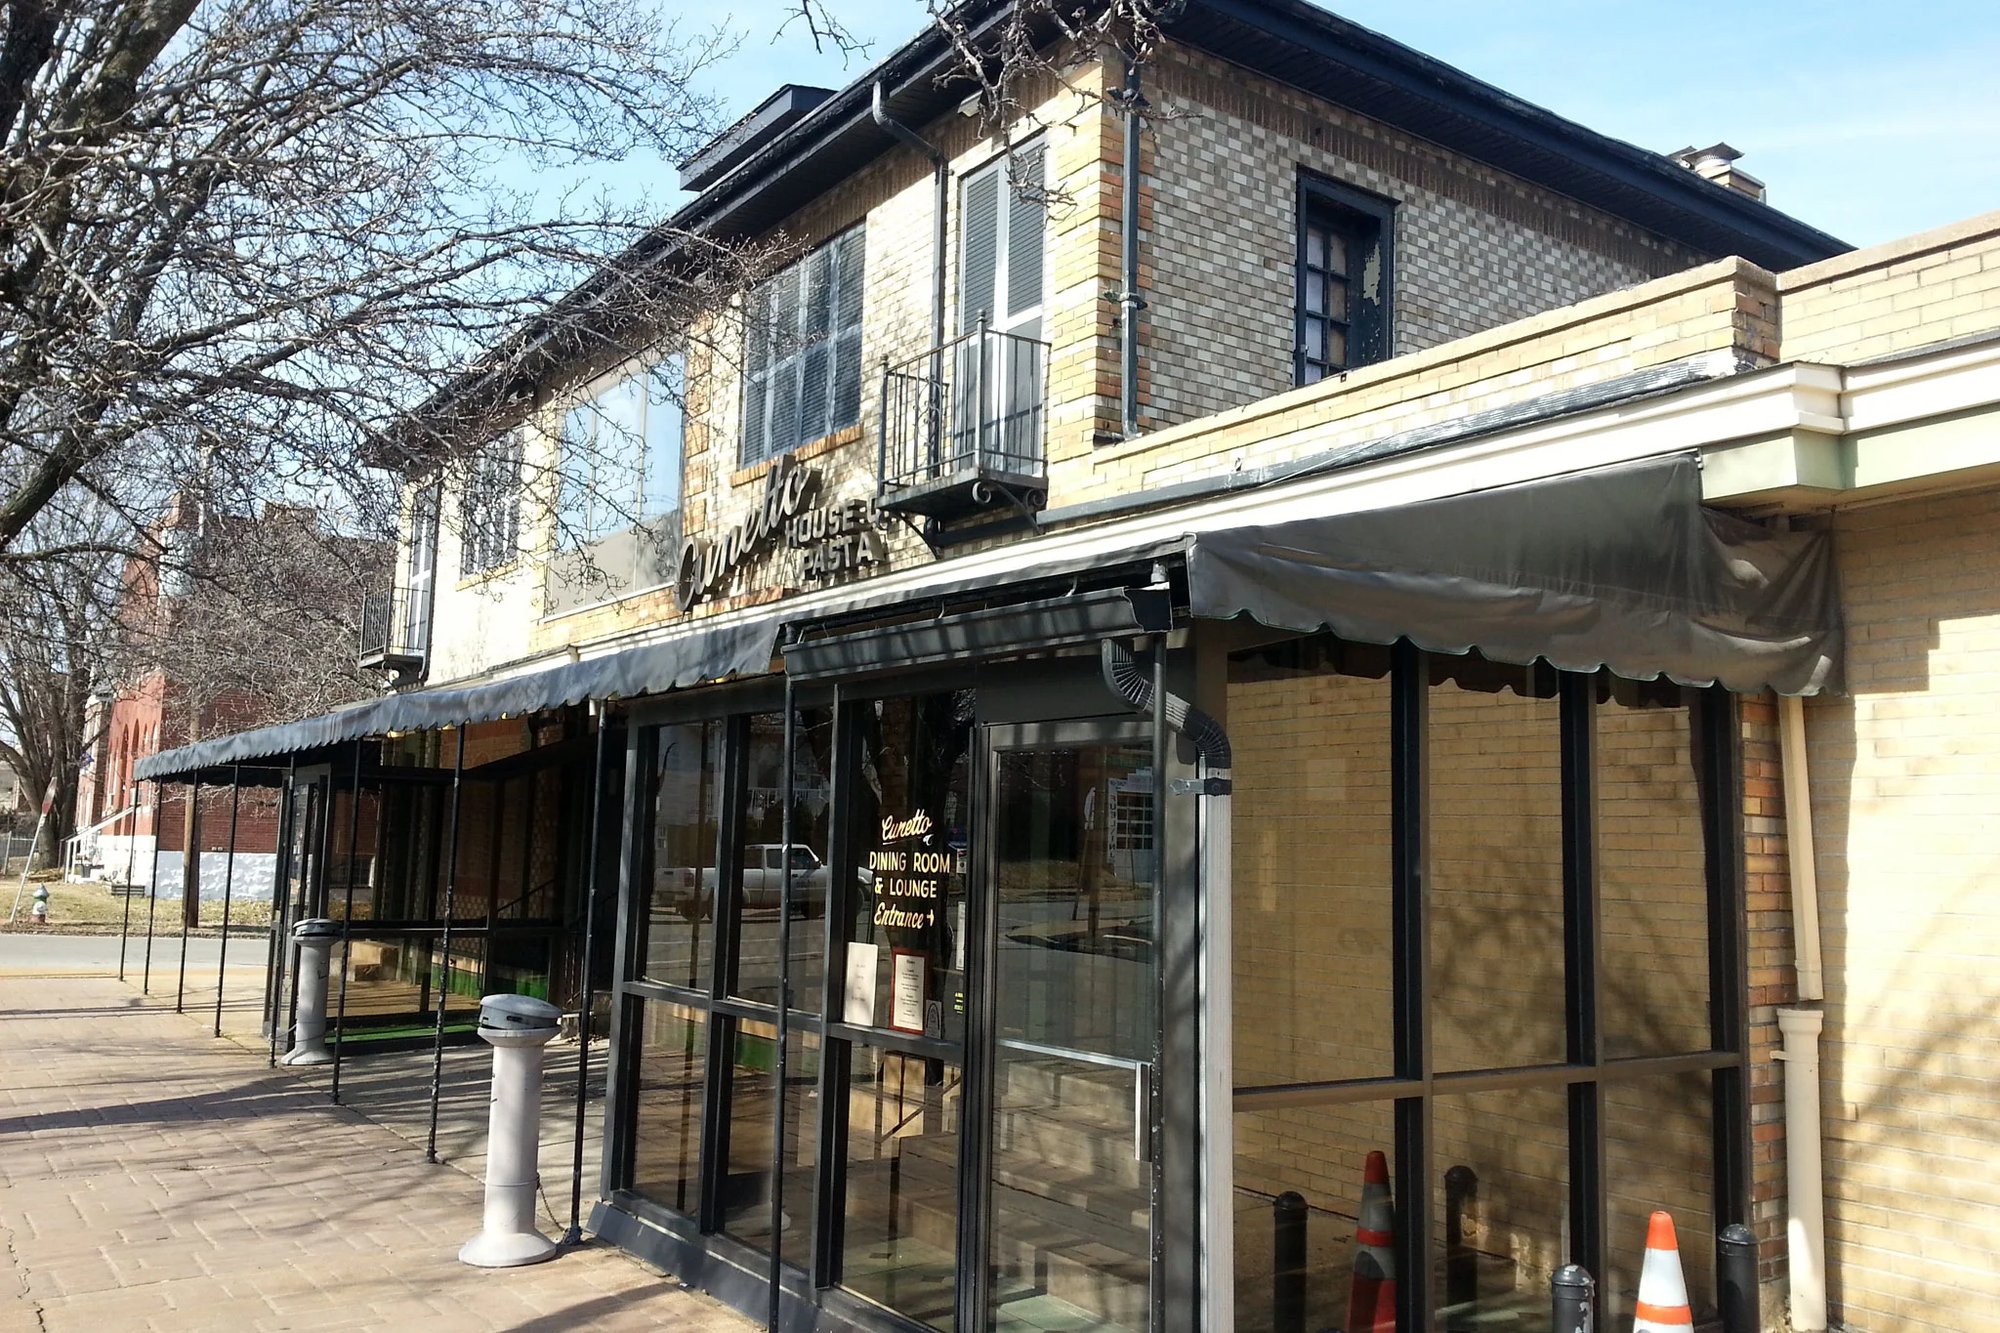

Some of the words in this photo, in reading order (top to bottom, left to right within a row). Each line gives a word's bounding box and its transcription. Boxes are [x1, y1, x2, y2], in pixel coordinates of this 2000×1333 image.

[674, 454, 816, 611] Cunetto
[785, 498, 857, 548] HOUSE
[799, 531, 876, 580] PASTA
[881, 808, 932, 841] Cunetto
[869, 851, 907, 871] DINING
[913, 852, 951, 873] ROOM
[874, 877, 884, 895] &
[889, 877, 937, 898] LOUNGE
[874, 901, 924, 929] Entrance
